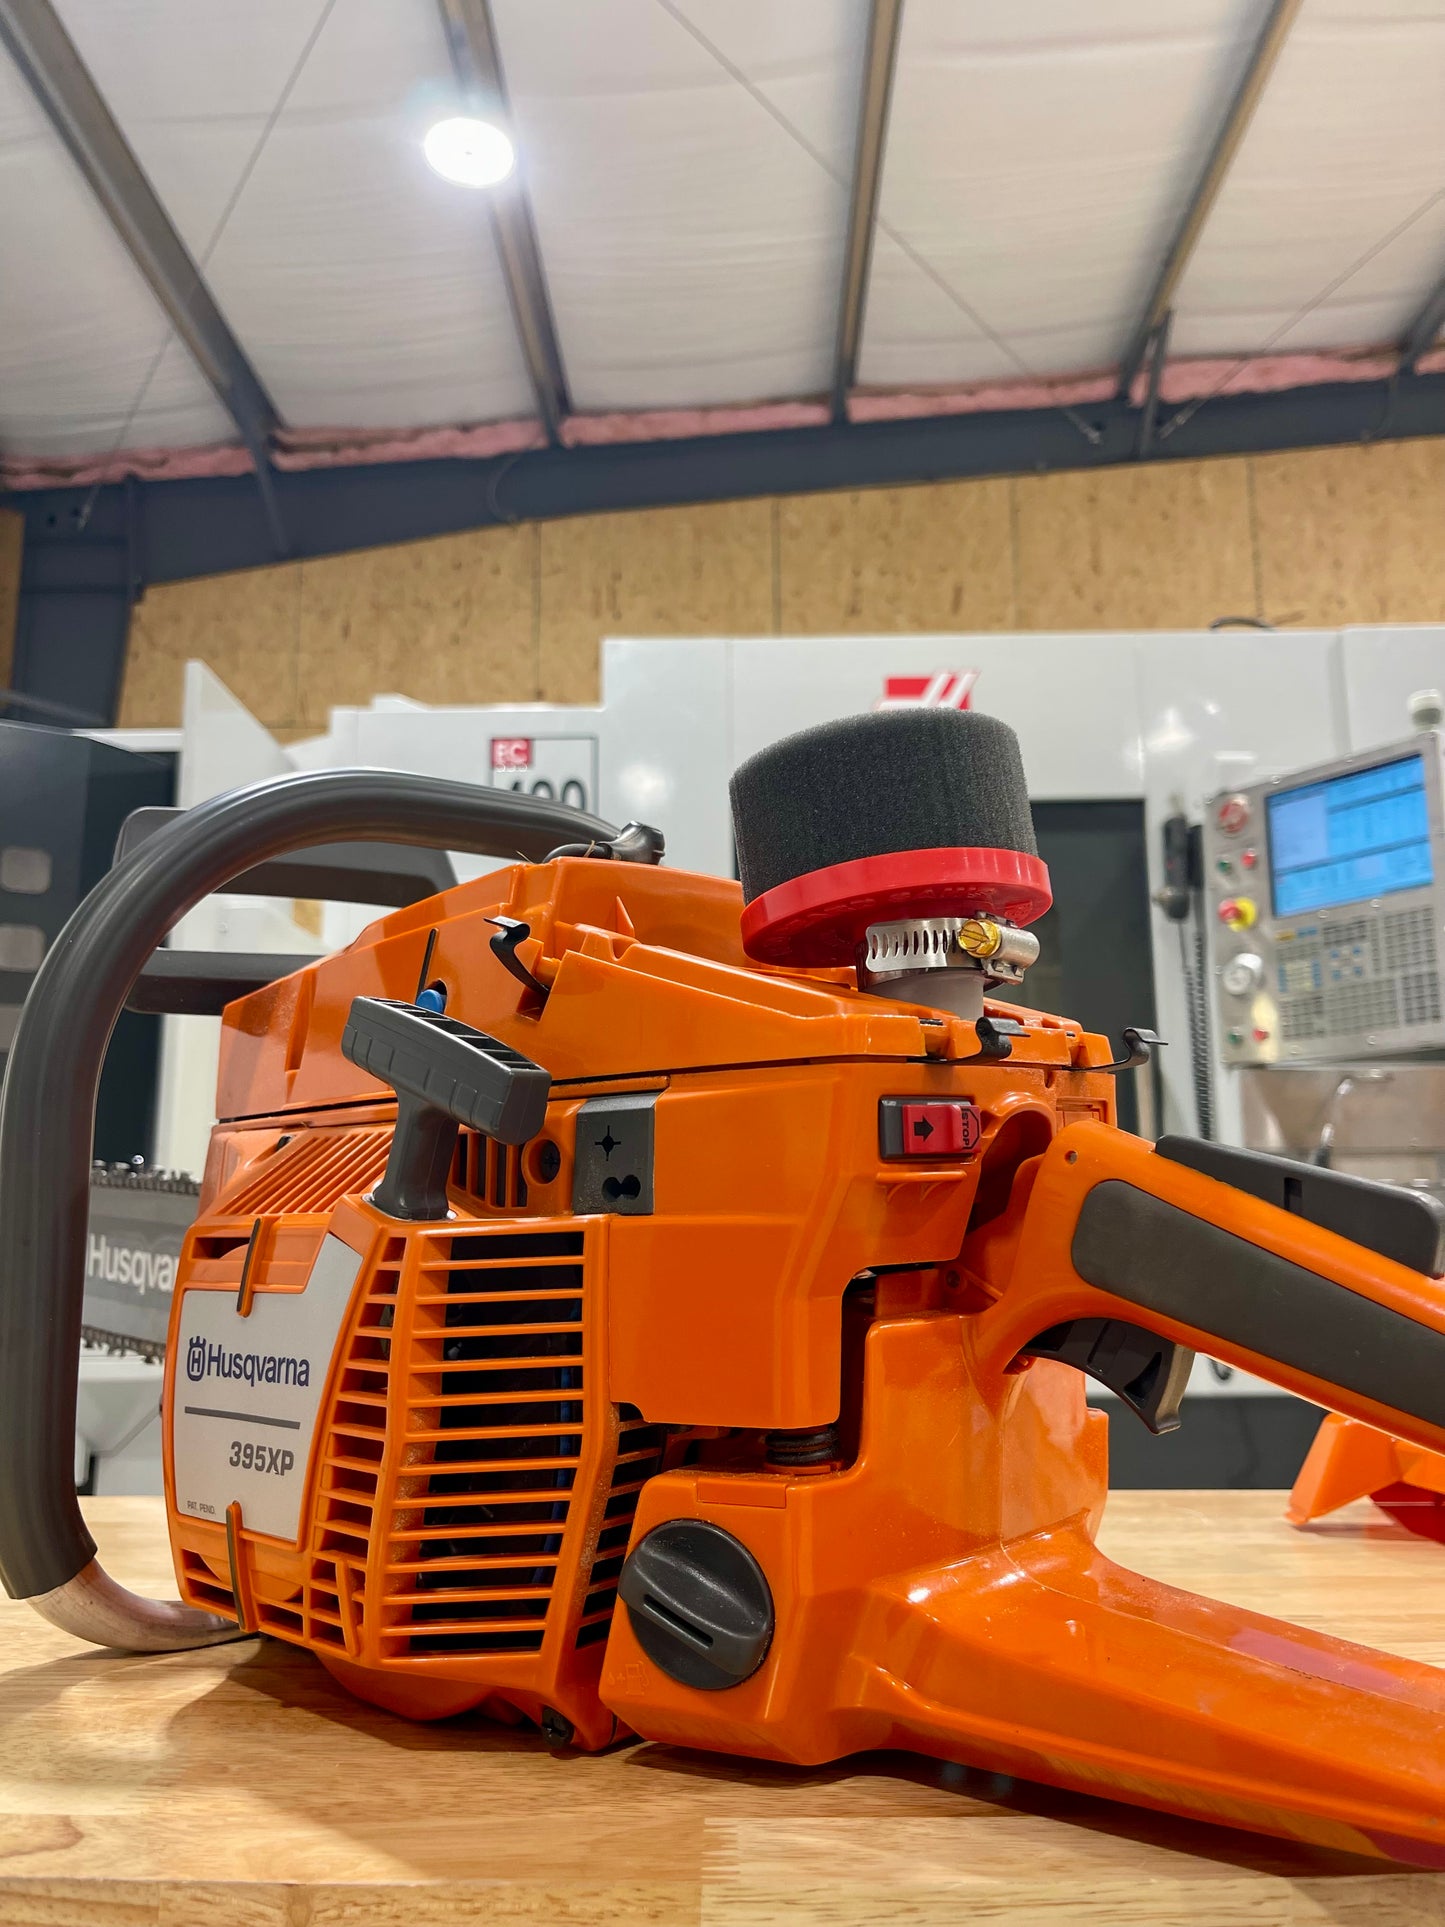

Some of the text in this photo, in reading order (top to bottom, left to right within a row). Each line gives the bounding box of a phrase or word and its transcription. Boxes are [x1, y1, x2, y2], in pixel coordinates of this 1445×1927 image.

[961, 1112, 970, 1147] STOP
[87, 1233, 180, 1295] Husqva
[206, 1343, 310, 1387] Husqvarna
[229, 1441, 294, 1476] 395XP
